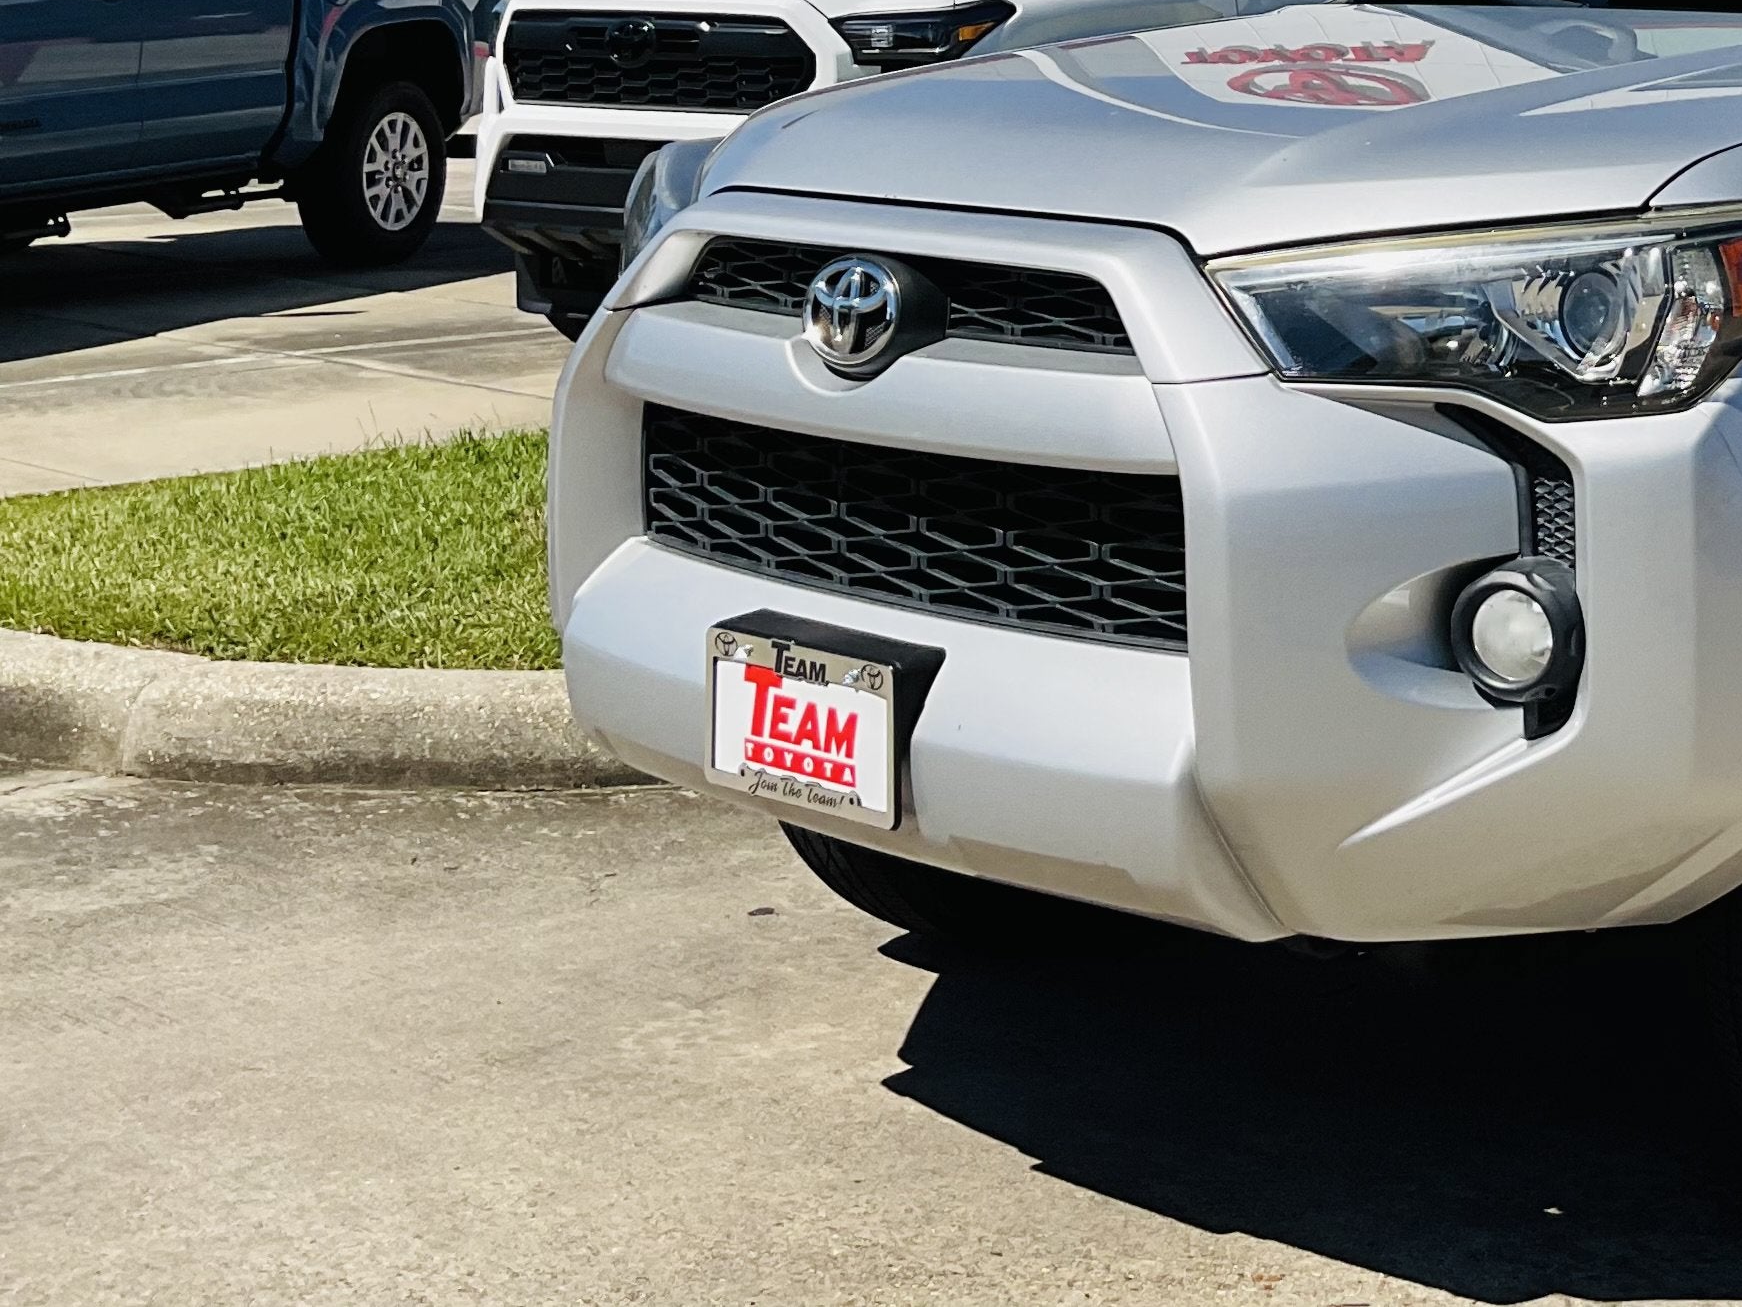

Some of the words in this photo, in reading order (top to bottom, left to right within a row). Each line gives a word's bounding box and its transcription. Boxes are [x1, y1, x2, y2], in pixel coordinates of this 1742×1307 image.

[744, 664, 859, 759] TEAM
[746, 743, 855, 783] TOYOTA
[748, 771, 778, 795] Join
[780, 777, 802, 798] The
